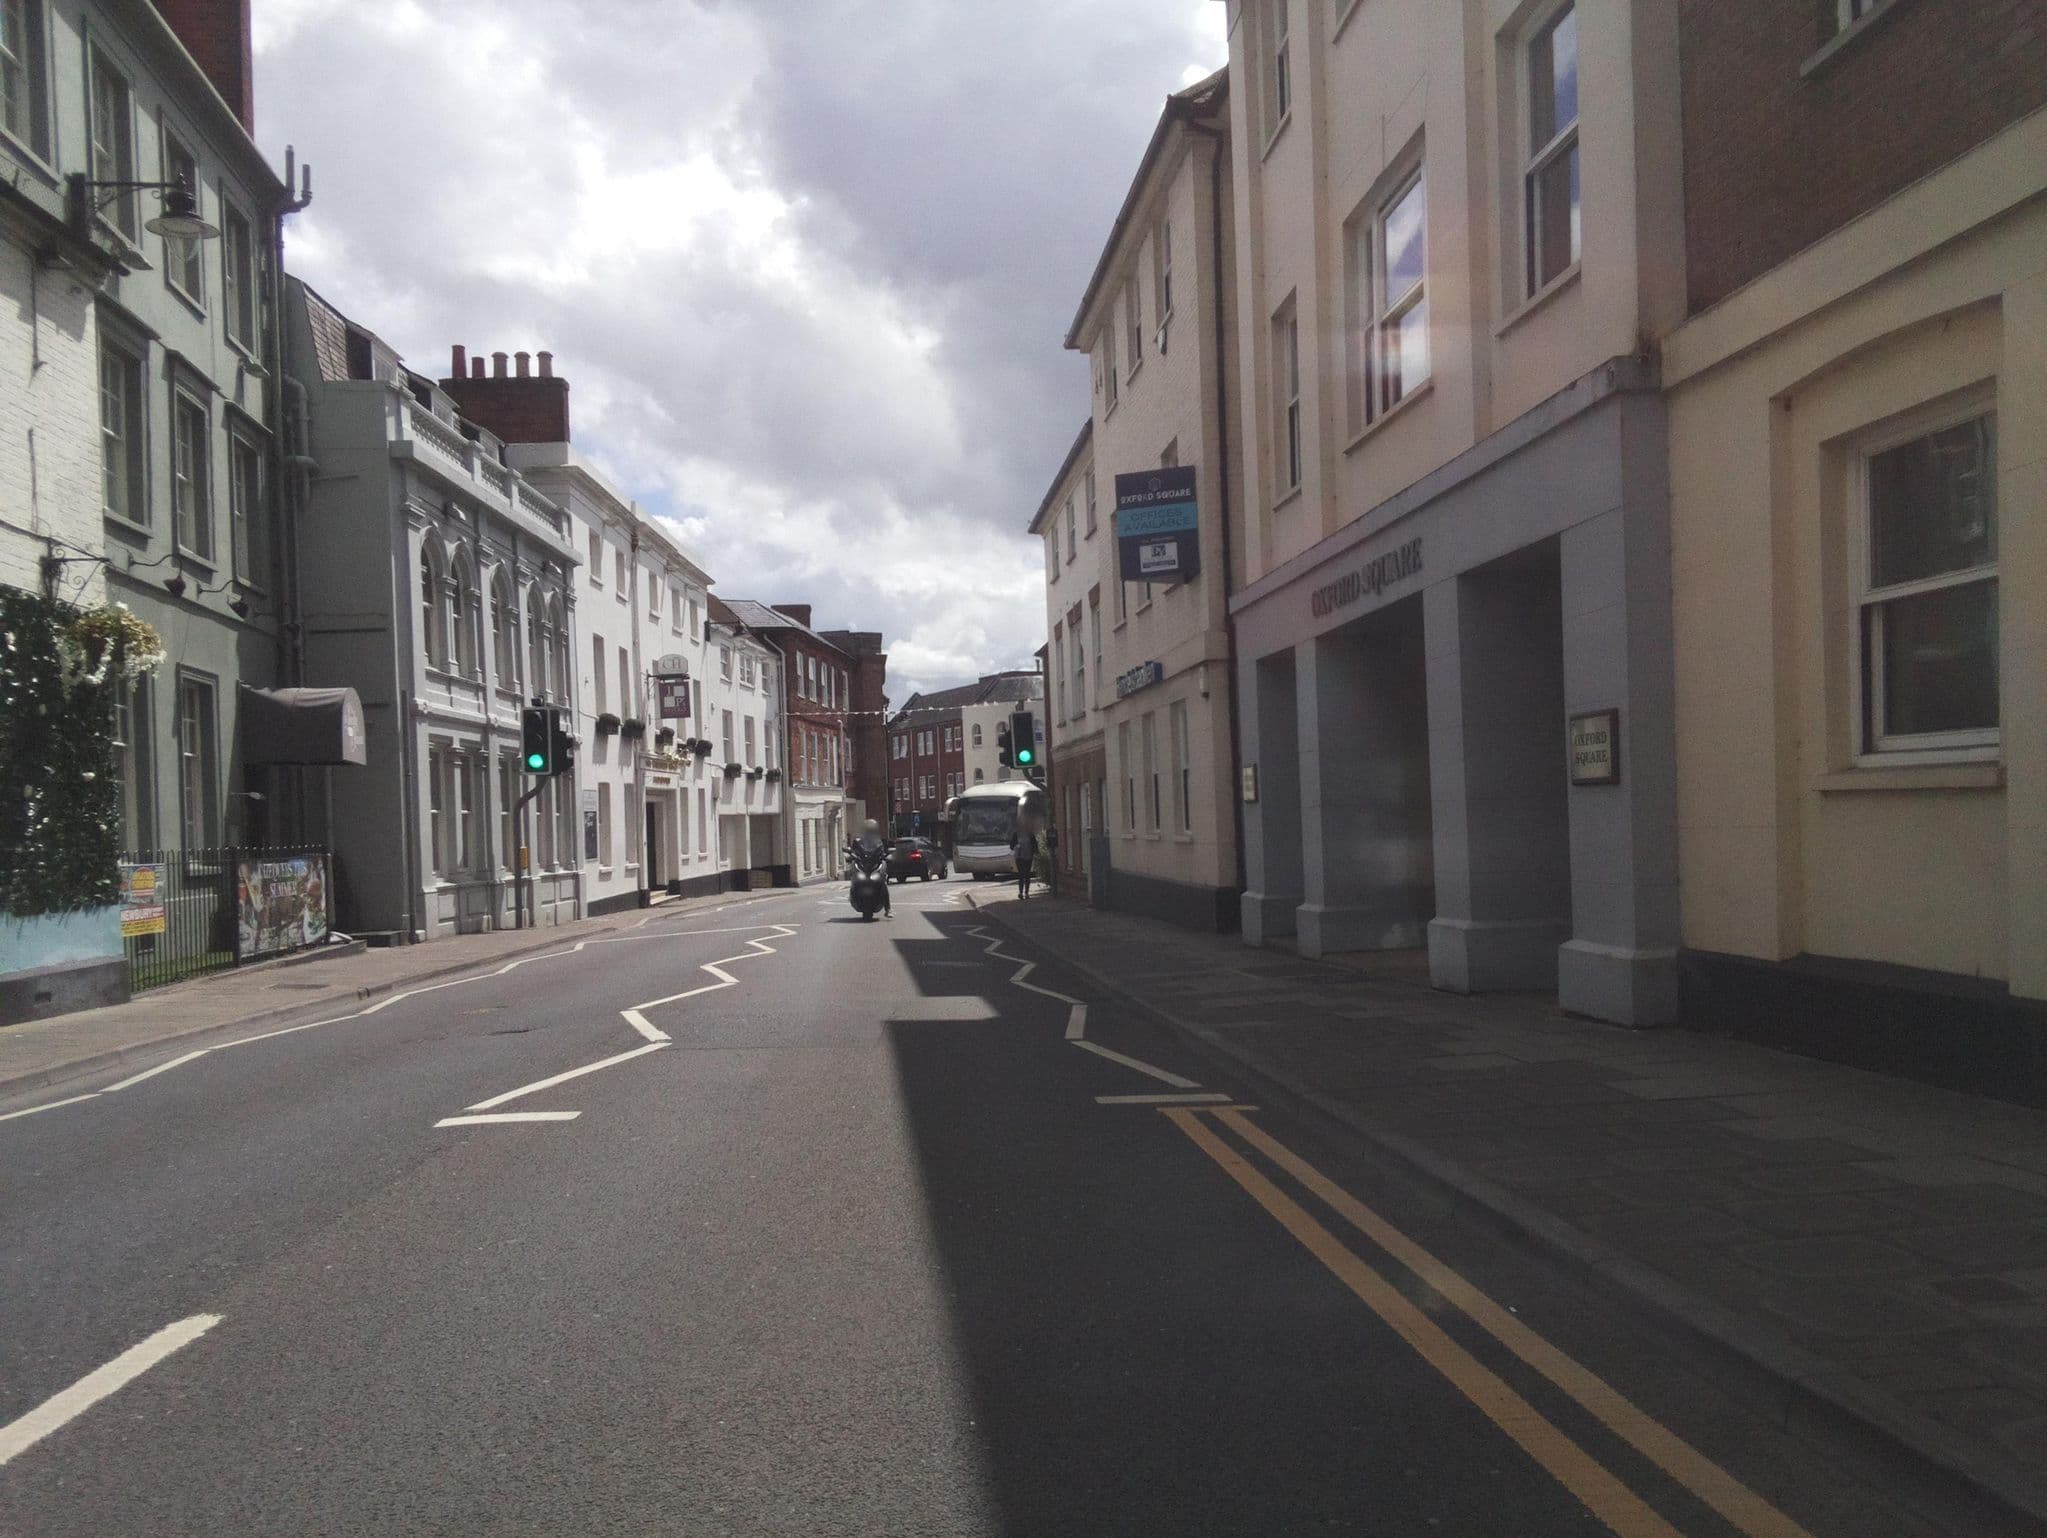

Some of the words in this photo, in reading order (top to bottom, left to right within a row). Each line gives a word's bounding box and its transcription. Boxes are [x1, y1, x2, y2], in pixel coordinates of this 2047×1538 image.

[1155, 488, 1191, 499] SQUARE
[1312, 571, 1360, 618] OXFORD
[1361, 537, 1422, 595] SQUARE
[1574, 731, 1607, 746] OXFORD
[1576, 750, 1608, 766] SQUARE
